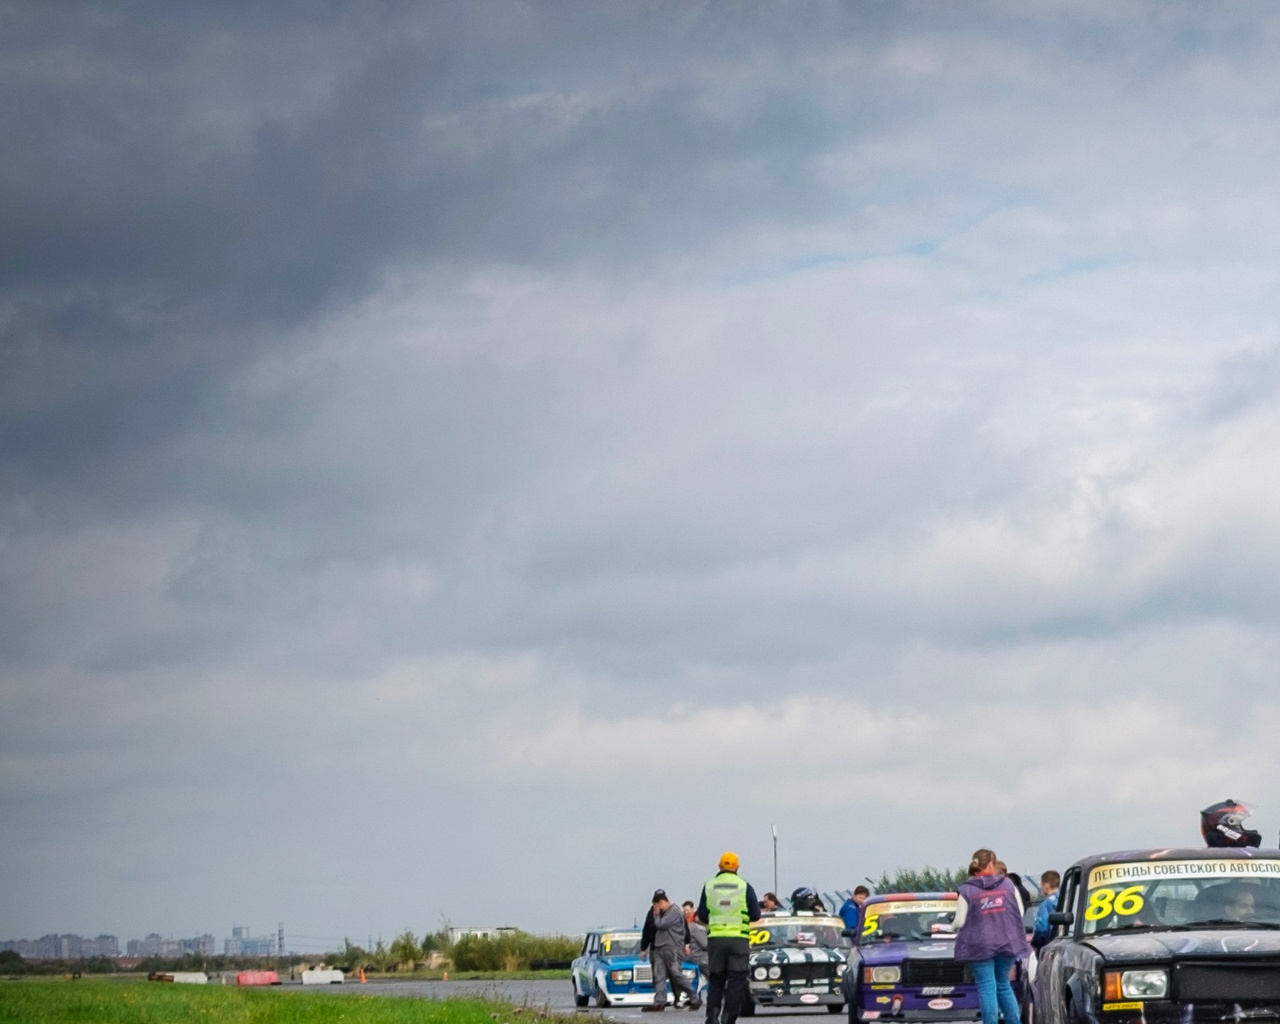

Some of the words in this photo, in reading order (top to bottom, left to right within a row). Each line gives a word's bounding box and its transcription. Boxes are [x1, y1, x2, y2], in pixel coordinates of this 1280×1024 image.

[1093, 867, 1152, 883] ЛЕГЕНДЫ
[1154, 863, 1227, 876] СОВЕТСКОГО
[1085, 885, 1145, 921] 86
[862, 914, 880, 936] 5
